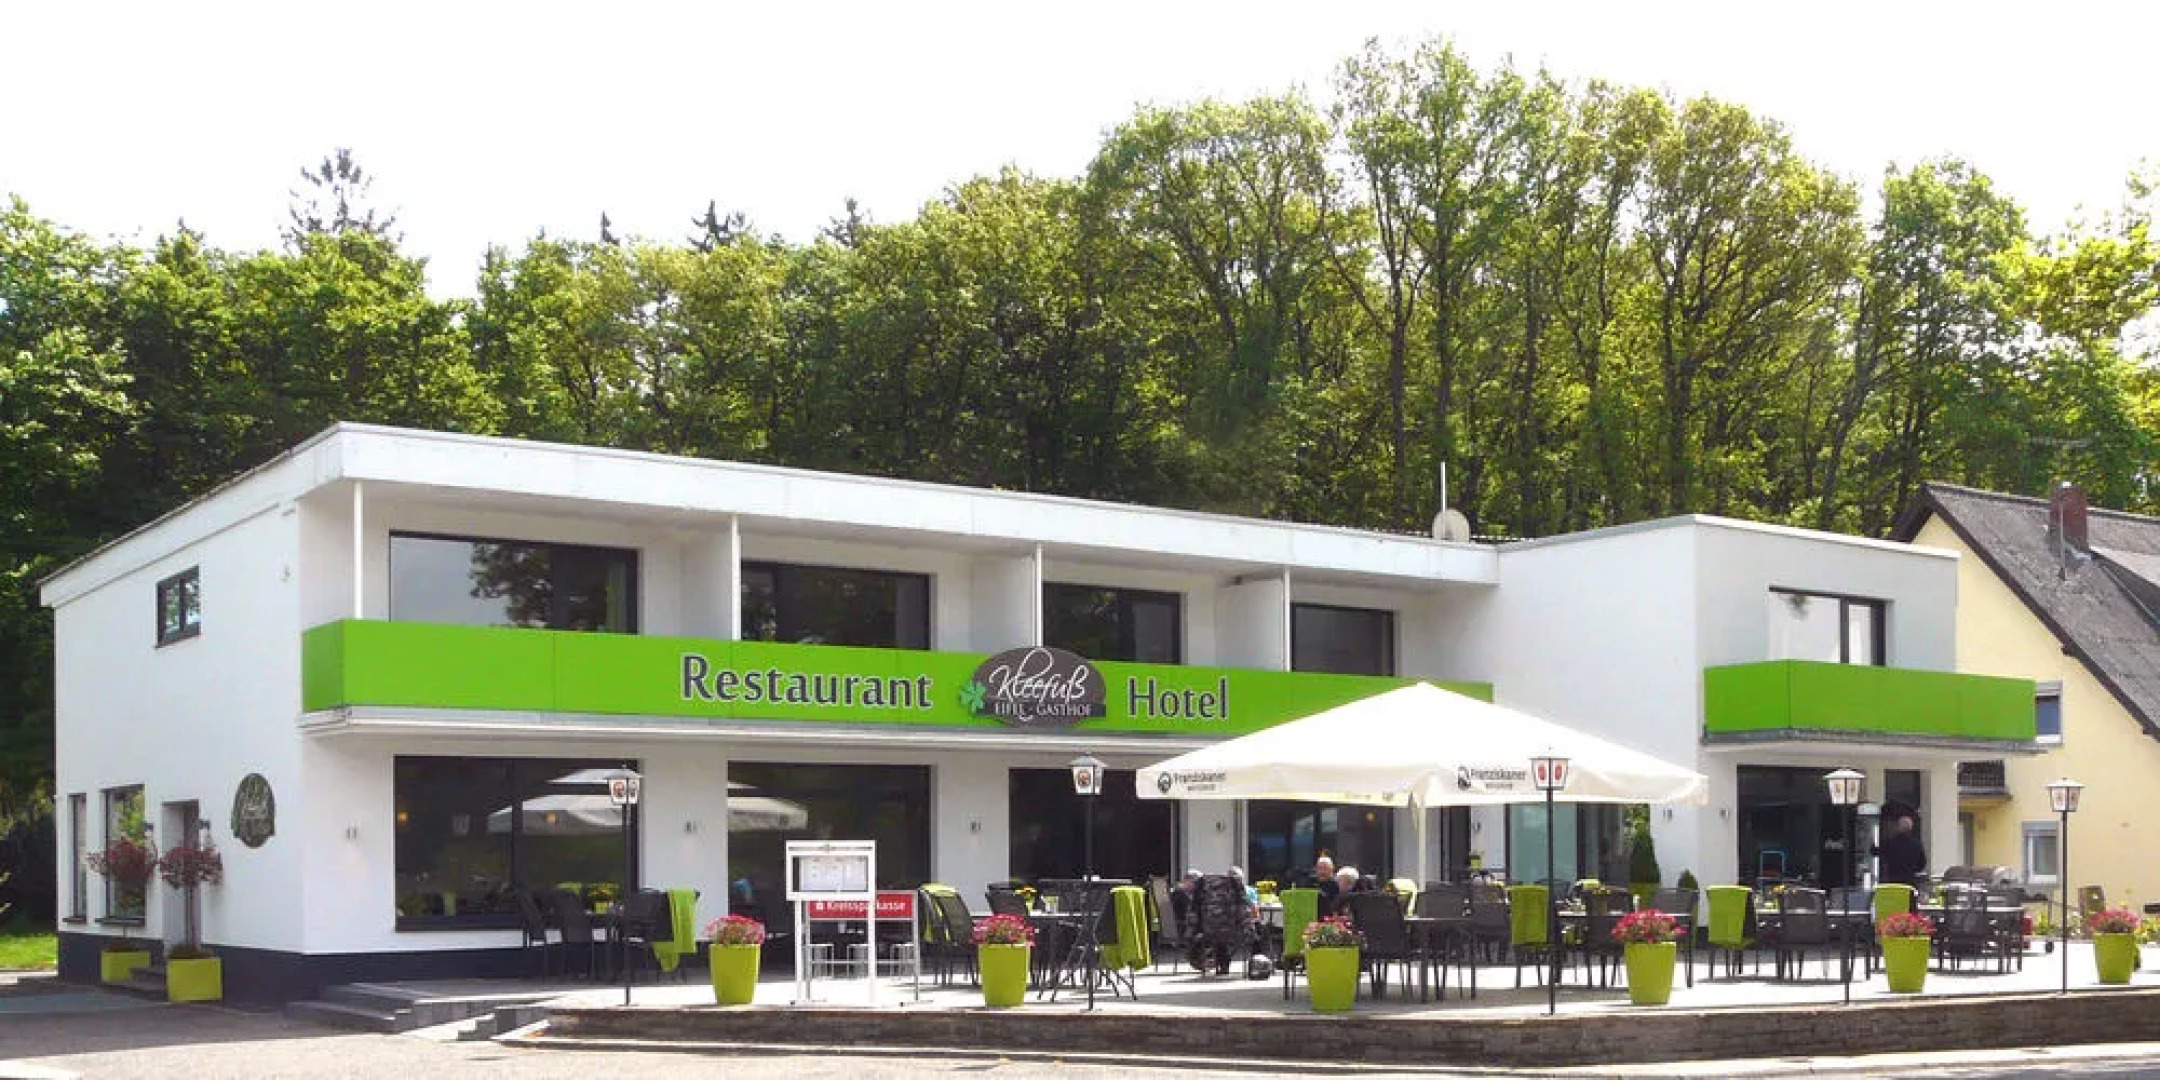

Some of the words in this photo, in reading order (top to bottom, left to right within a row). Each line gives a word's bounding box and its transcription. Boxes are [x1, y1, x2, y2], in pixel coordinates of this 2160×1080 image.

[681, 653, 933, 708] Restaurant
[988, 648, 1090, 721] Kleefuß
[1128, 676, 1229, 719] Hotel
[1036, 703, 1091, 716] GASTHOF
